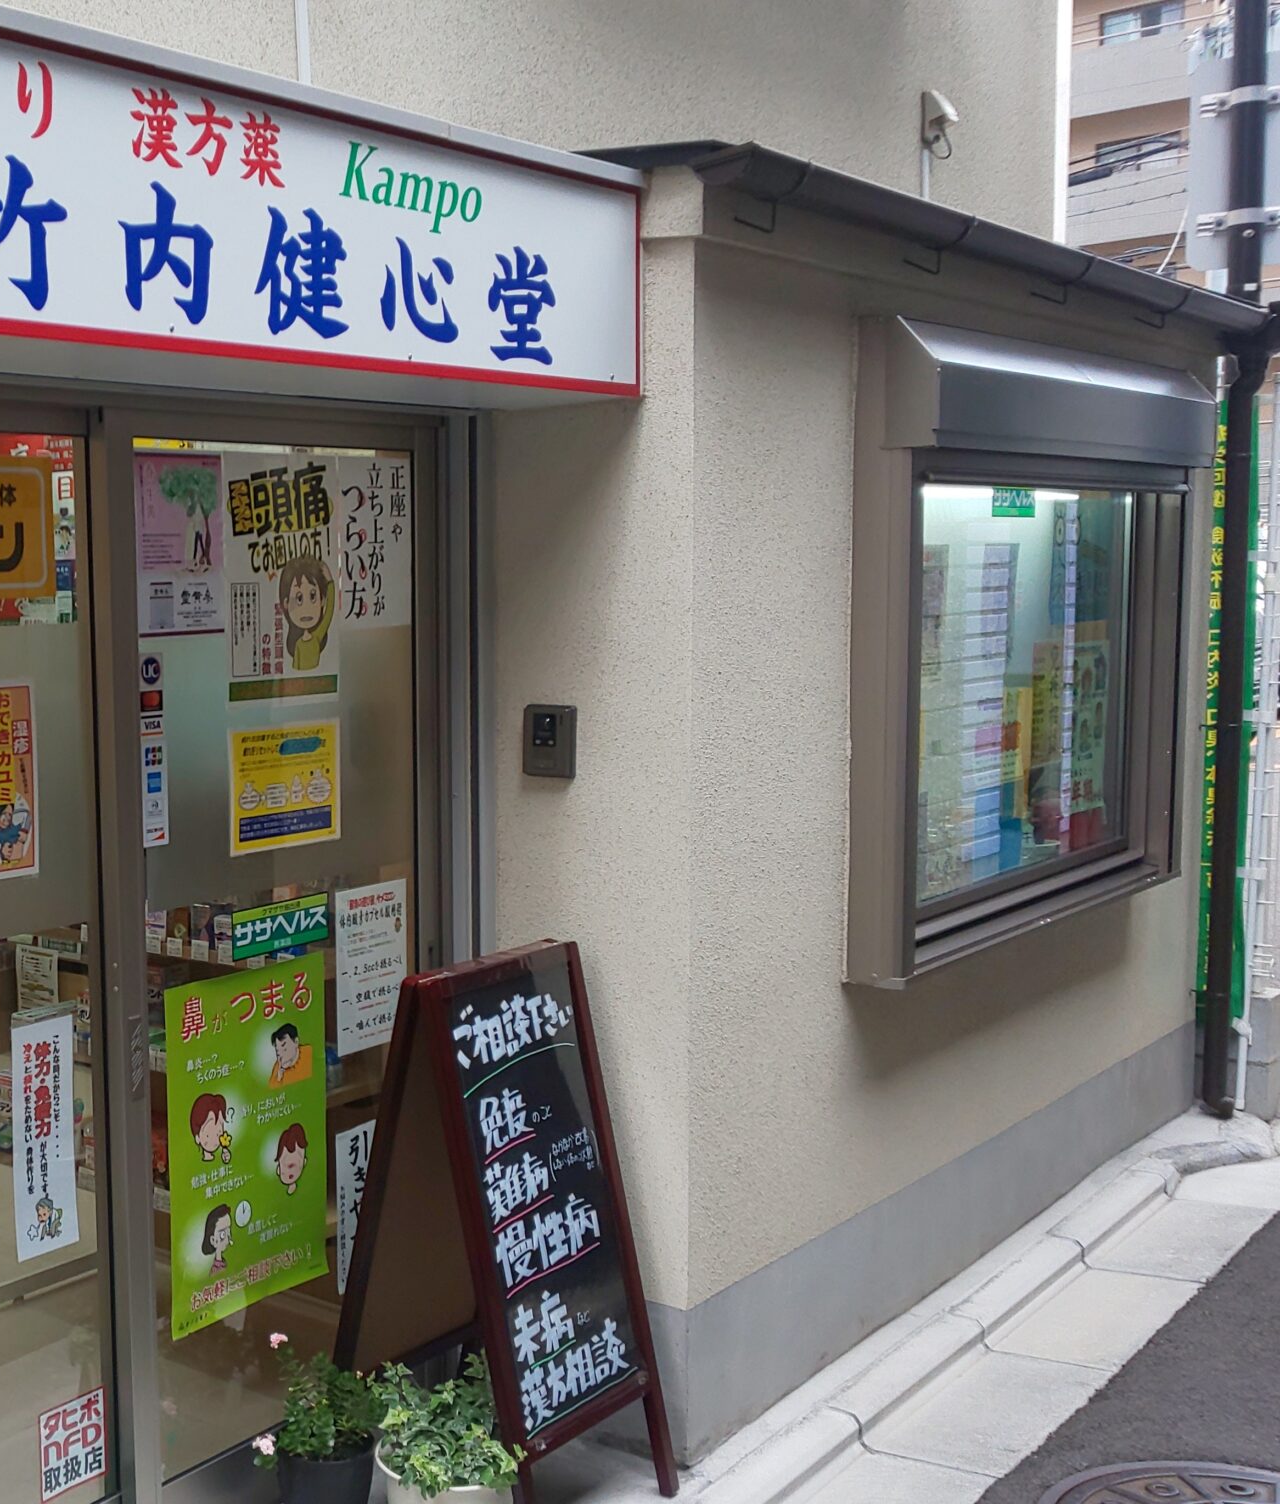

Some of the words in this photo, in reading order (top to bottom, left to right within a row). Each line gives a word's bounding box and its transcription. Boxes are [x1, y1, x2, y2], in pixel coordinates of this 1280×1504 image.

[130, 86, 286, 190] 漢方薬
[338, 140, 483, 234] Kampo
[250, 461, 331, 538] 頭痛
[389, 465, 407, 544] 正座や
[341, 484, 368, 621] つらい方
[141, 662, 160, 680] UC
[144, 720, 162, 731] VISA
[234, 905, 328, 947] ササヘルス
[451, 993, 573, 1070] ご相談下さい
[494, 1192, 601, 1288] 慢性病
[520, 1318, 630, 1432] 漢方相談
[43, 1392, 102, 1440] タヒボ
[43, 1447, 103, 1494] 取扱店
